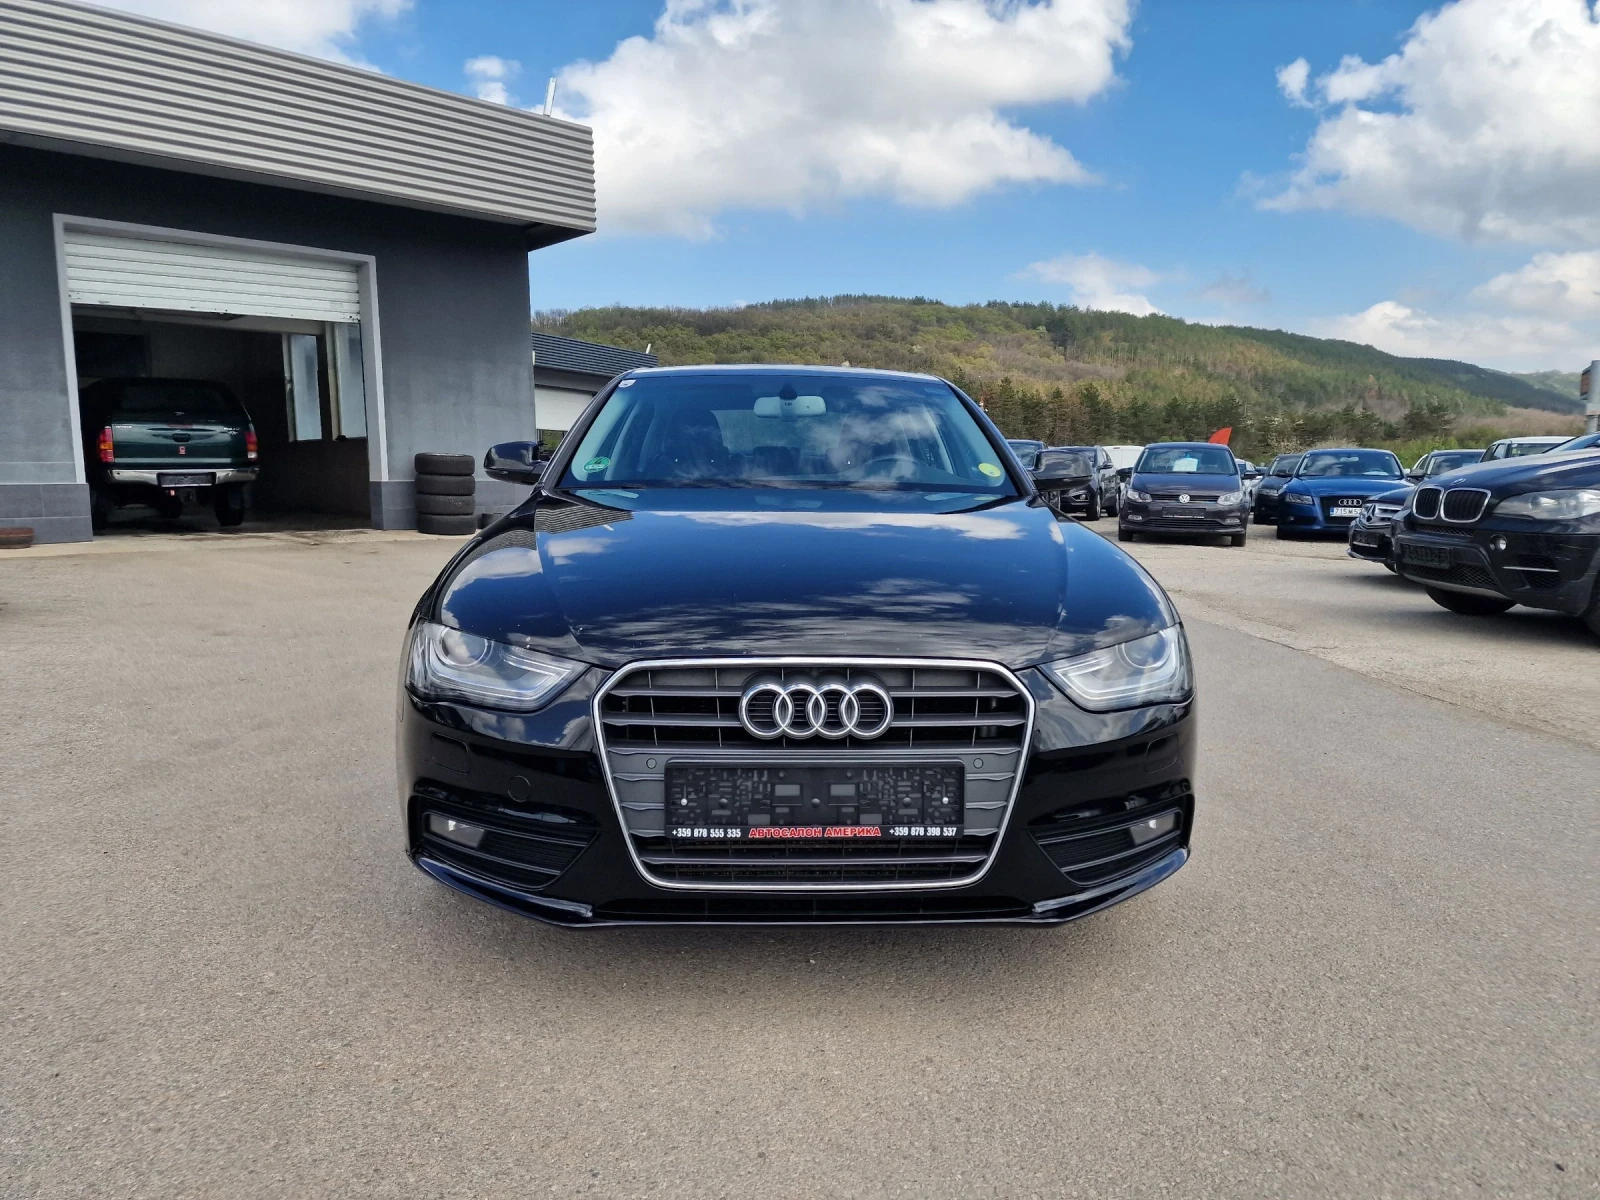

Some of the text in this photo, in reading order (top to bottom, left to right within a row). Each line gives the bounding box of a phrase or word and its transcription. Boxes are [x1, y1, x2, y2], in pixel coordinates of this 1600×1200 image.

[672, 828, 691, 837] +359
[710, 828, 724, 838] 555
[726, 828, 742, 838] 335
[748, 827, 823, 839] АВТОСАЛОН
[824, 826, 882, 838] АМЕРИКА
[889, 827, 908, 836] +359
[910, 827, 925, 836] 878
[926, 827, 941, 837] 398
[943, 827, 957, 837] 537
